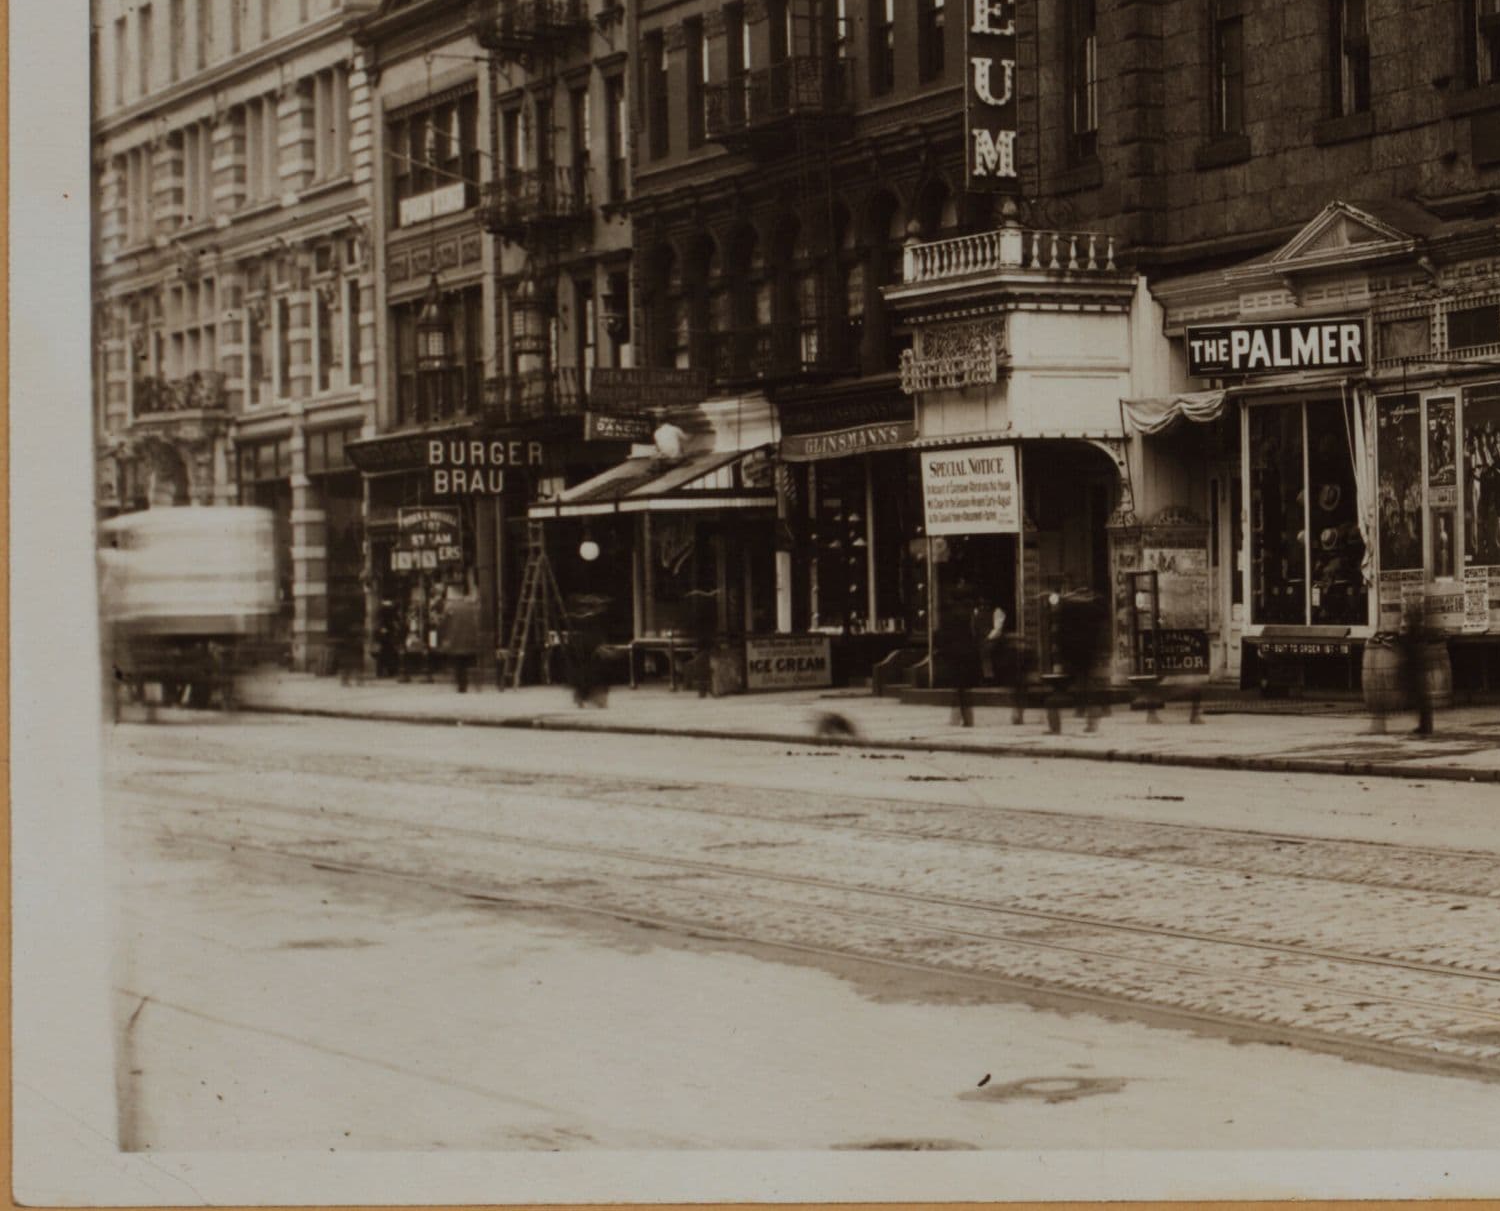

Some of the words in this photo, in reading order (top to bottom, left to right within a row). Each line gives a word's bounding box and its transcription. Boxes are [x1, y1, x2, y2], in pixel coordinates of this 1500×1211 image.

[1189, 338, 1231, 363] THE
[1230, 323, 1363, 370] PALMER
[428, 440, 543, 466] BURGER
[929, 460, 967, 478] SPECIAL
[968, 457, 1004, 475] NOTICE
[433, 469, 504, 495] BRAU
[750, 659, 771, 673] ICE
[776, 657, 825, 673] CREAM
[1144, 656, 1208, 669] TILOR.
